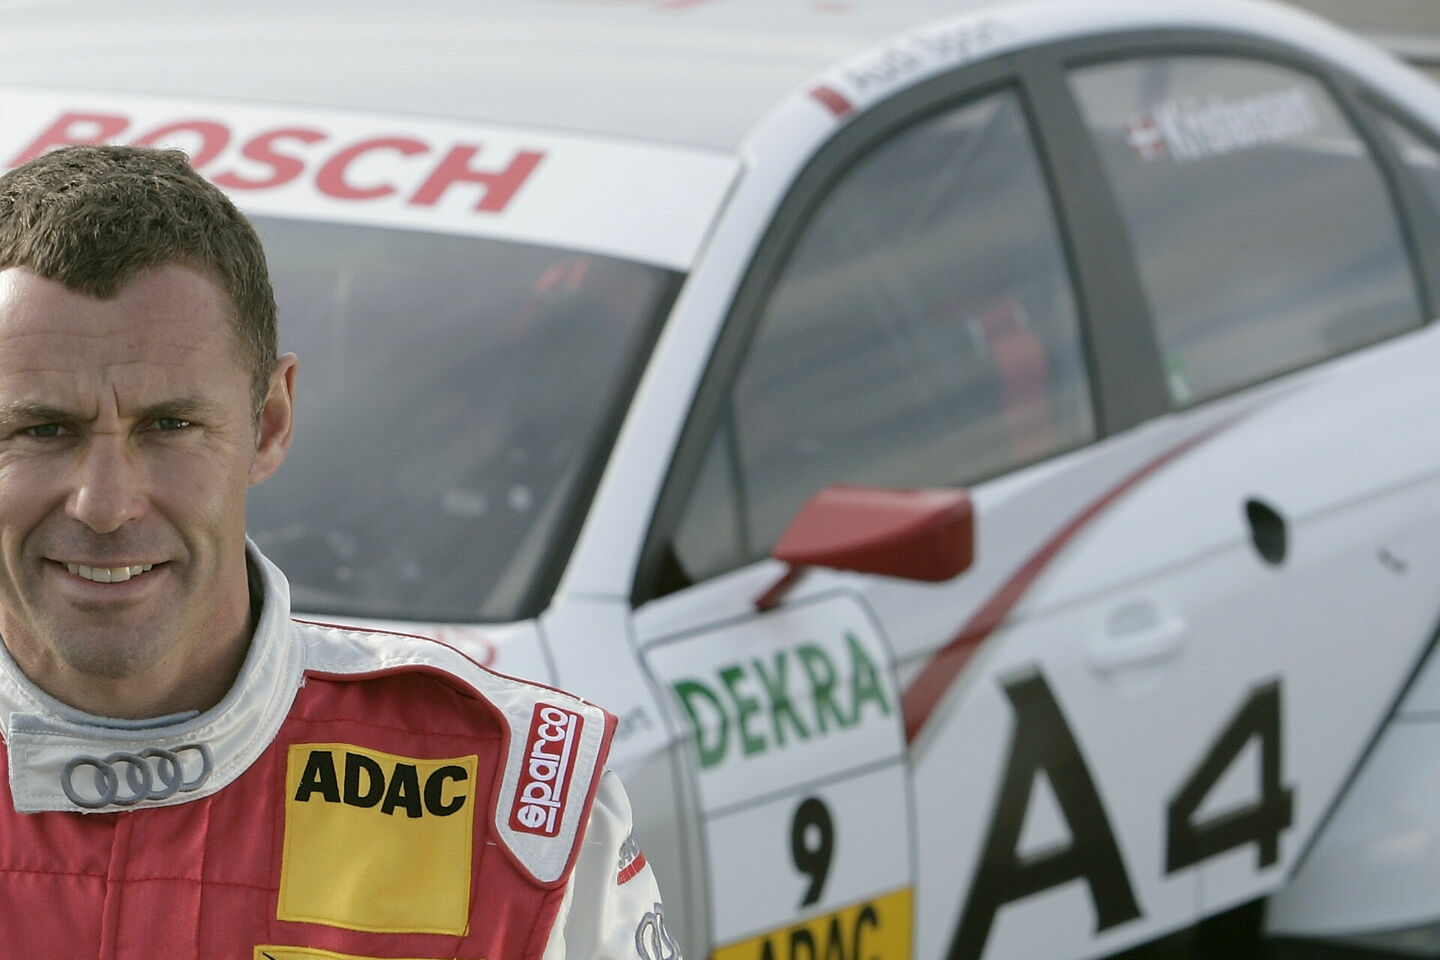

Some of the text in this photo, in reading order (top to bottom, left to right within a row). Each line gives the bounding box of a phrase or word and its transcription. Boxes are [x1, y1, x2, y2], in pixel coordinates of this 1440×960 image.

[672, 632, 893, 769] DEKRA
[294, 750, 469, 819] ADAC
[516, 706, 577, 834] sparco
[790, 796, 834, 908] 9
